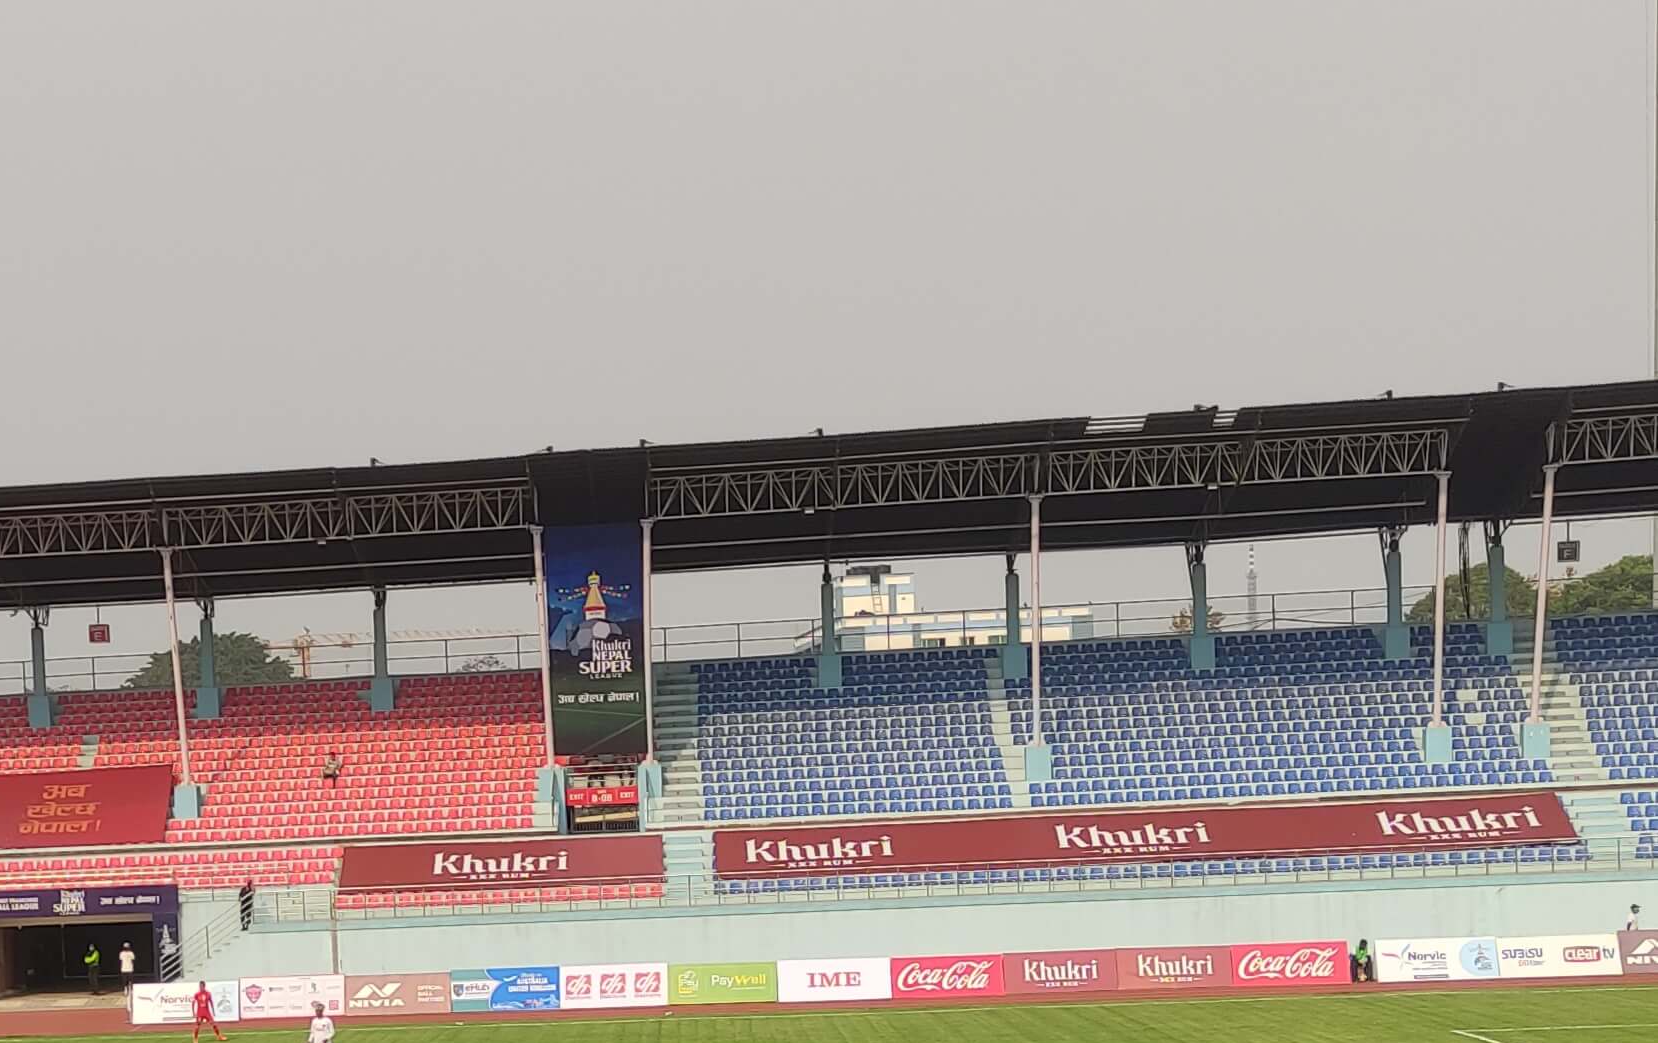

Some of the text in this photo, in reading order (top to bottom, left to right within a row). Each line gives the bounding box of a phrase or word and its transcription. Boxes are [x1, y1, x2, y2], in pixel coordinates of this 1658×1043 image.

[592, 650, 632, 661] NEPAL
[579, 660, 632, 674] SUPER
[42, 783, 92, 800] अब
[1375, 805, 1541, 837] Khukri
[1055, 822, 1211, 851] Khukri
[745, 834, 893, 864] Khukri
[432, 850, 569, 876] Khukri
[1138, 955, 1213, 977] Khukri
[1238, 948, 1339, 980] Coca-Cola
[1408, 950, 1446, 961] Norvic
[806, 971, 861, 988] IME
[897, 960, 995, 992] Coca-Cola
[1024, 959, 1099, 981] Khukri
[349, 999, 406, 1008] NIVIA
